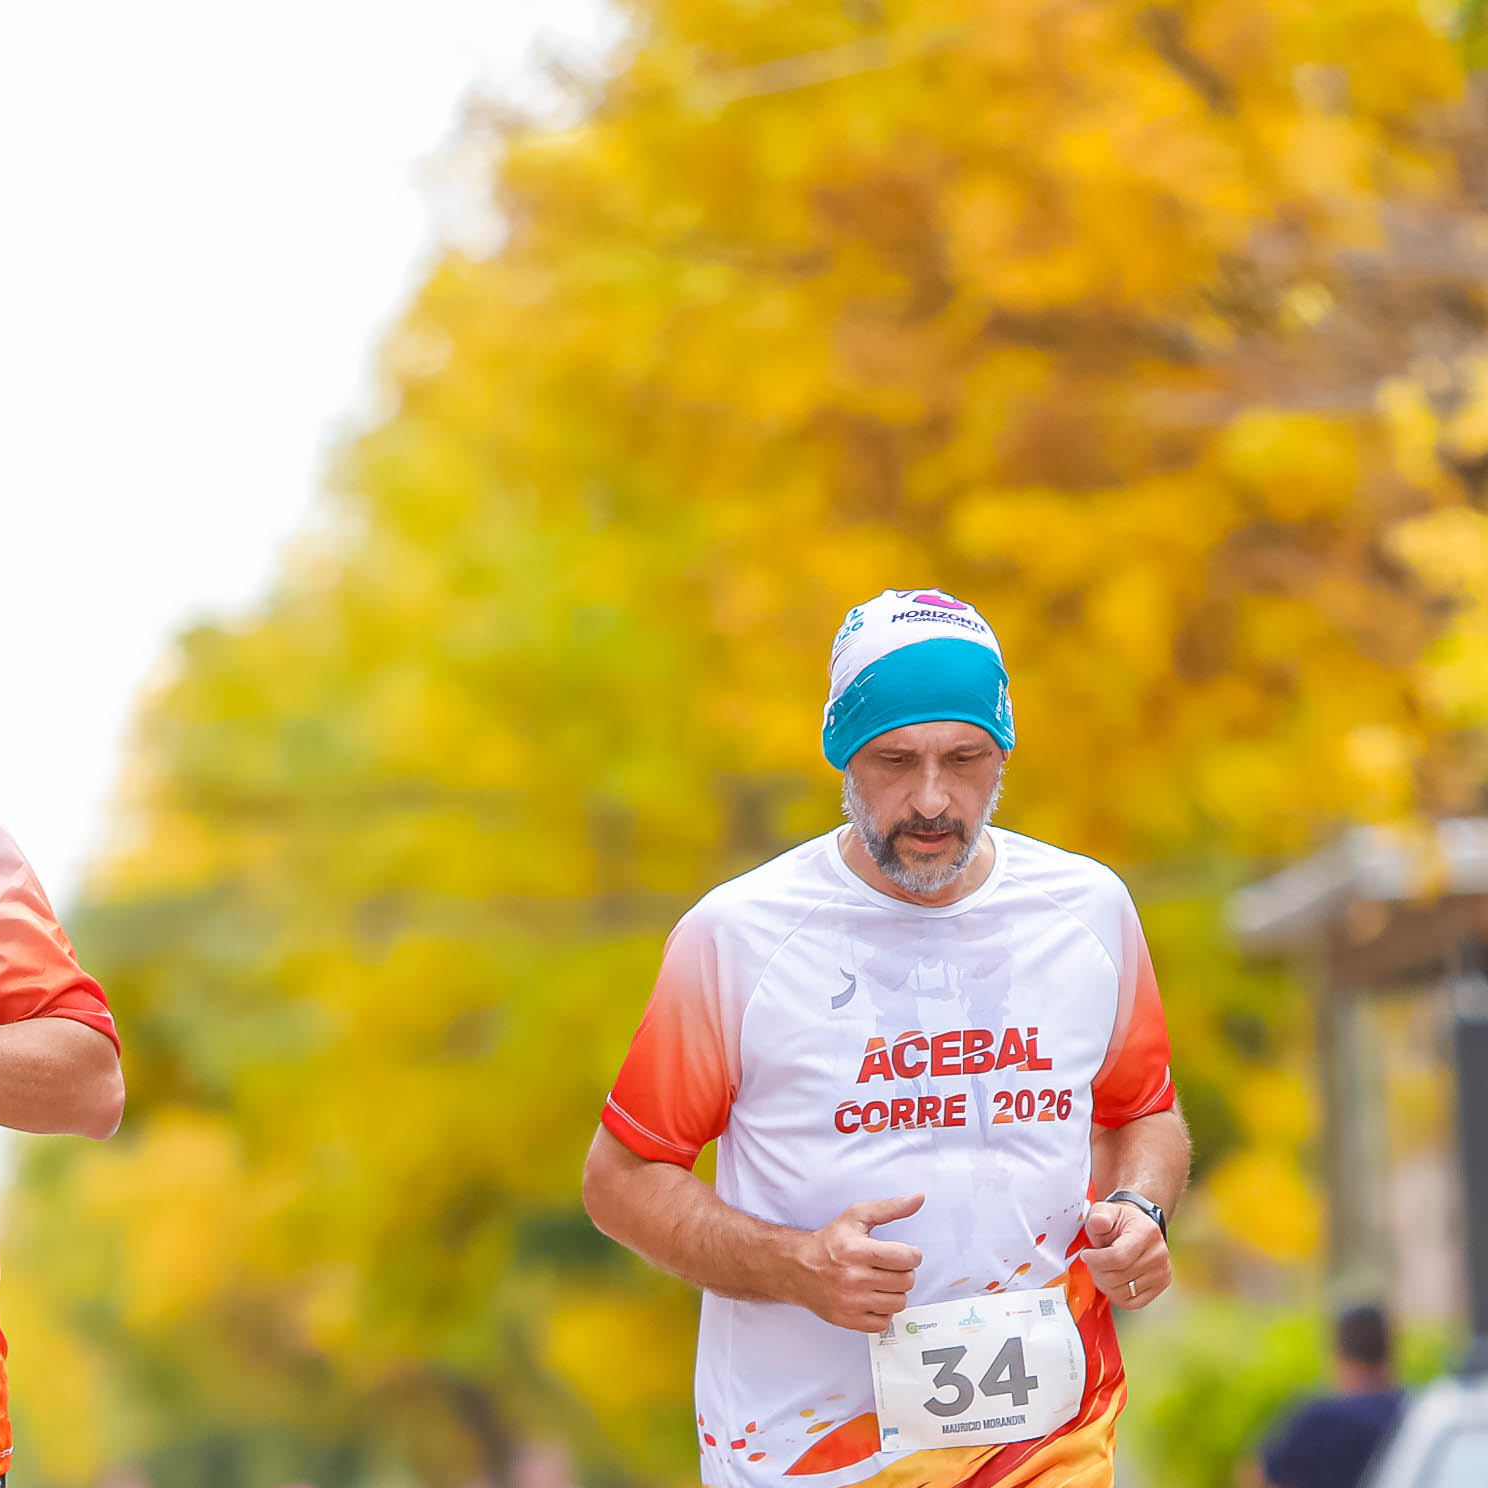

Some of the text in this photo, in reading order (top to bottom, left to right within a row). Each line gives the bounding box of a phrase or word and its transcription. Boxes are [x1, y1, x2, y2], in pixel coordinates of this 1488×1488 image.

[892, 609, 987, 633] HORIZONTE
[856, 1027, 1052, 1083] ACEBAL
[834, 1089, 1072, 1134] CORRE 2026
[922, 1337, 1038, 1417] 34
[942, 1414, 1026, 1434] MAURICIO MORANDIN
